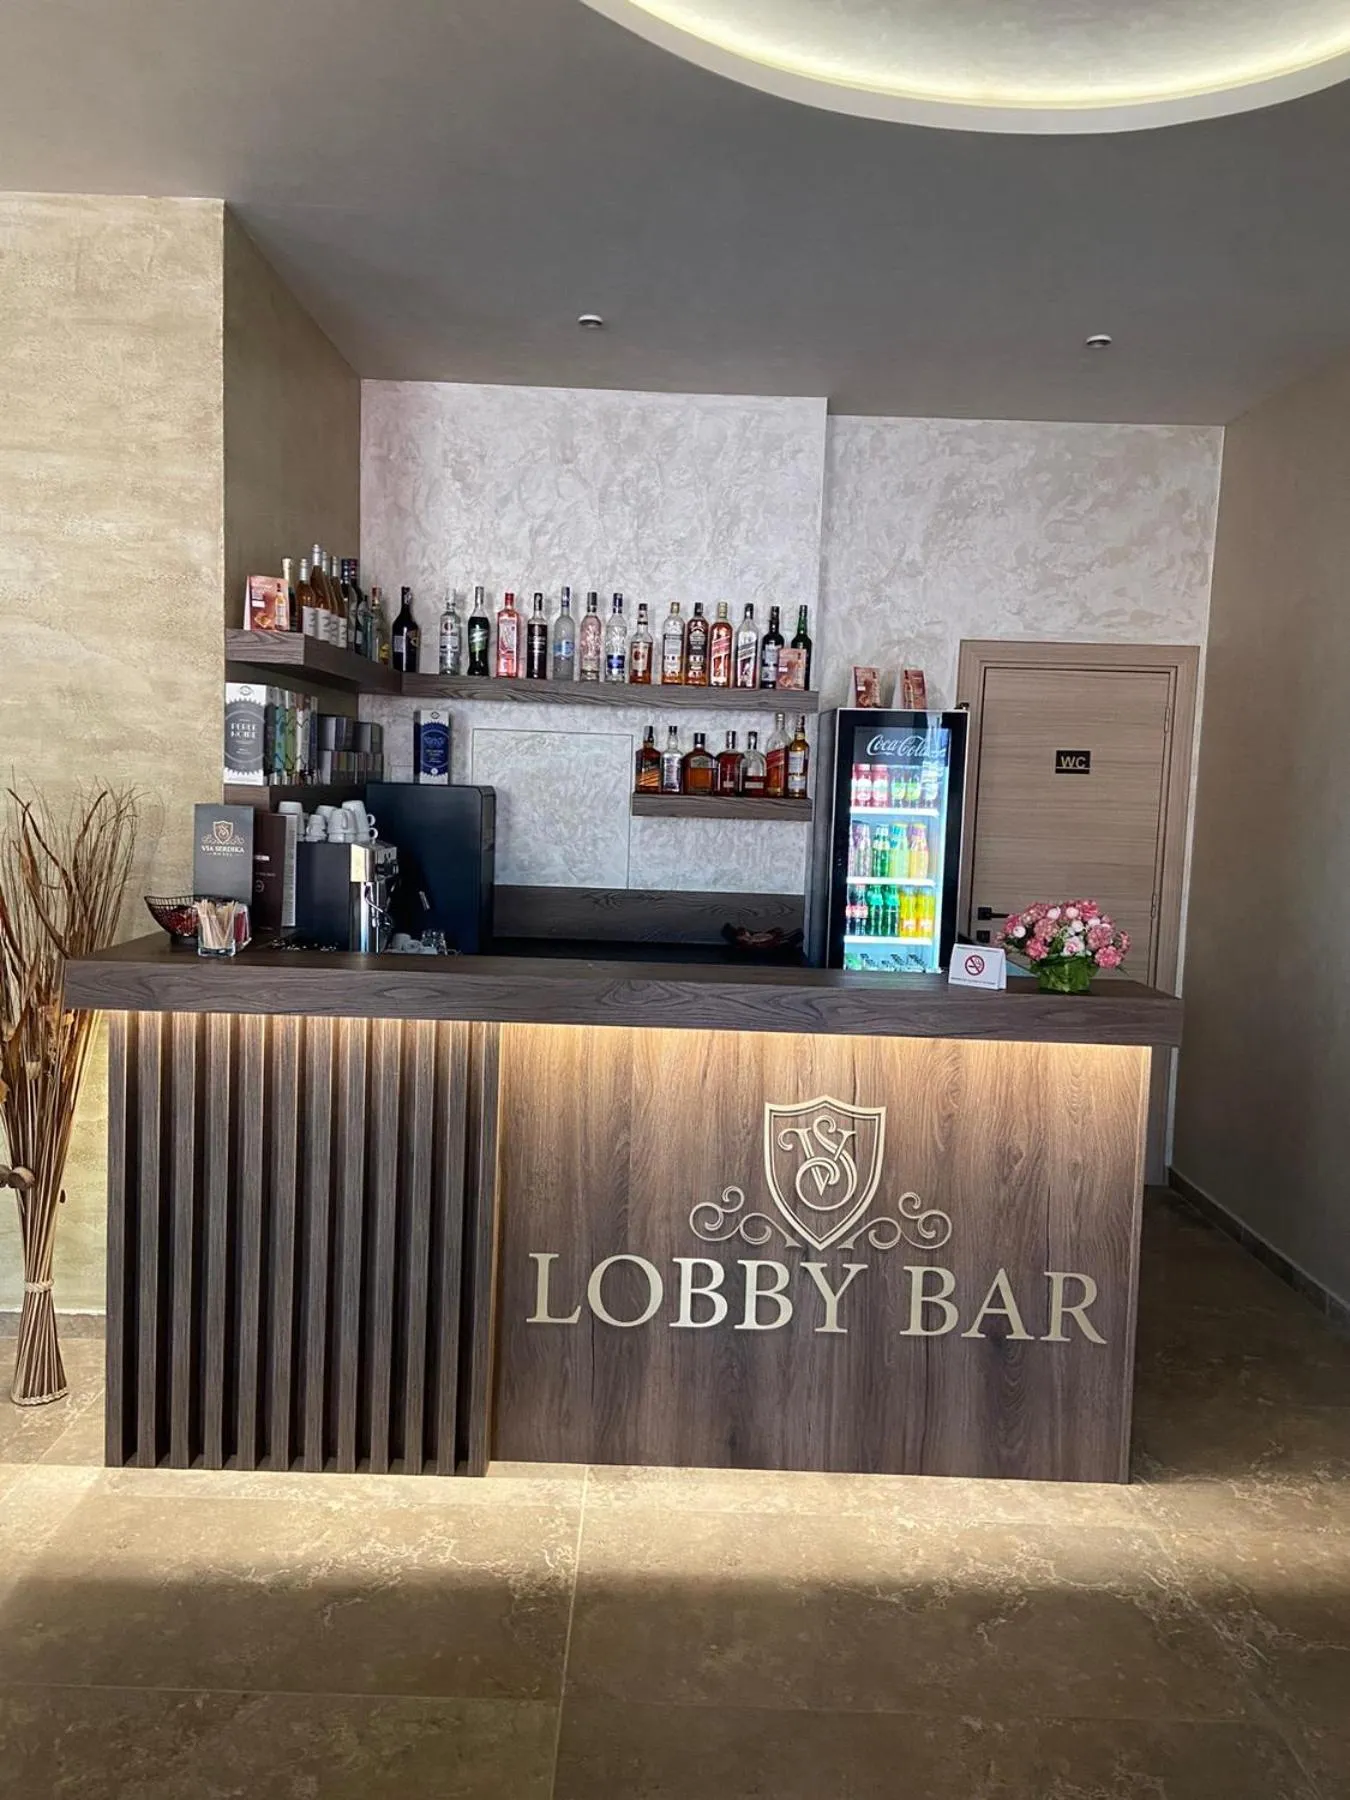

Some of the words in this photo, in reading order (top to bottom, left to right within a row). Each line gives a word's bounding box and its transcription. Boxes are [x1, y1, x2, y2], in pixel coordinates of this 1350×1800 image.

[865, 734, 930, 757] Coca-Cola
[1060, 755, 1087, 769] WC
[526, 1252, 868, 1333] LOBBY
[900, 1265, 1108, 1344] BAR
